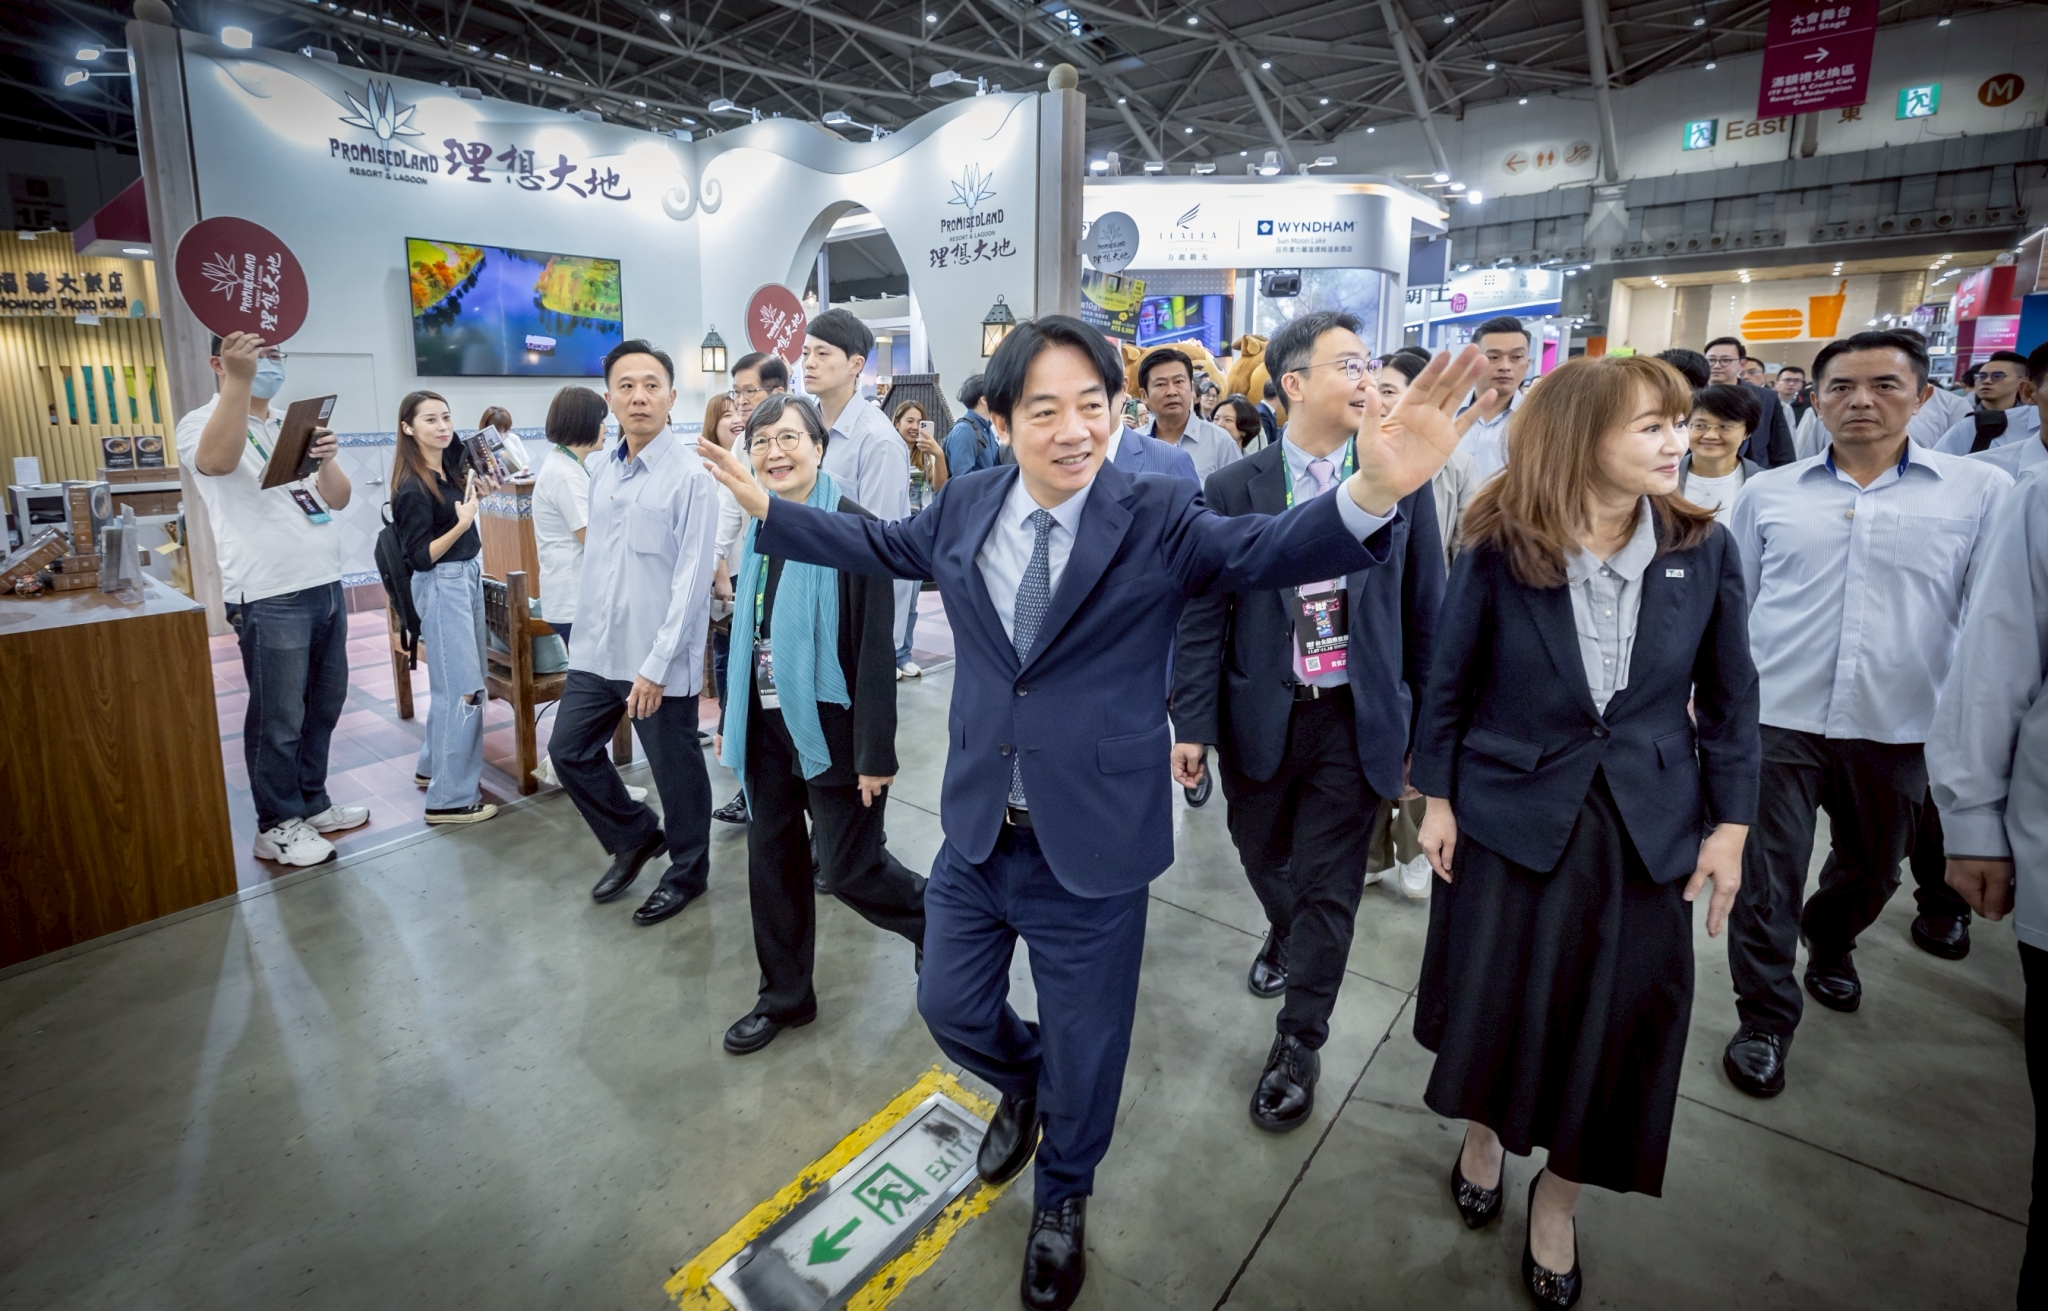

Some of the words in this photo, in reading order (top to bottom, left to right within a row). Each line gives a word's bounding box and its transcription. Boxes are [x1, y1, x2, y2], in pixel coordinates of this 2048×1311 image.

[1791, 25, 1816, 36] Main
[1818, 20, 1847, 31] Stage
[1808, 80, 1834, 90] Credit
[1836, 76, 1857, 85] Card
[1769, 92, 1802, 103] Rewards
[1803, 85, 1853, 97] Redemption
[1792, 96, 1826, 106] Counter
[1837, 106, 1863, 124] 東
[1725, 116, 1787, 142] East
[329, 137, 439, 173] PROMISEDLAND
[349, 166, 383, 179] RESORT
[386, 172, 392, 180] &
[394, 173, 428, 185] LAGOON
[443, 138, 632, 200] 理想大地
[940, 208, 1004, 233] PROMISEDLAND
[1277, 221, 1355, 233] WYNDHAM
[949, 233, 969, 242] RESORT
[974, 230, 996, 239] LAGOON
[1277, 237, 1289, 245] Sun
[1290, 237, 1310, 245] Moon
[1311, 237, 1327, 245] Lake
[929, 238, 1017, 268] 理想大地
[1092, 252, 1131, 264] 理想大地
[260, 252, 281, 331] 理想大地
[61, 297, 98, 310] Plaza
[99, 295, 127, 309] Hotel
[924, 1138, 973, 1182] EXIT
